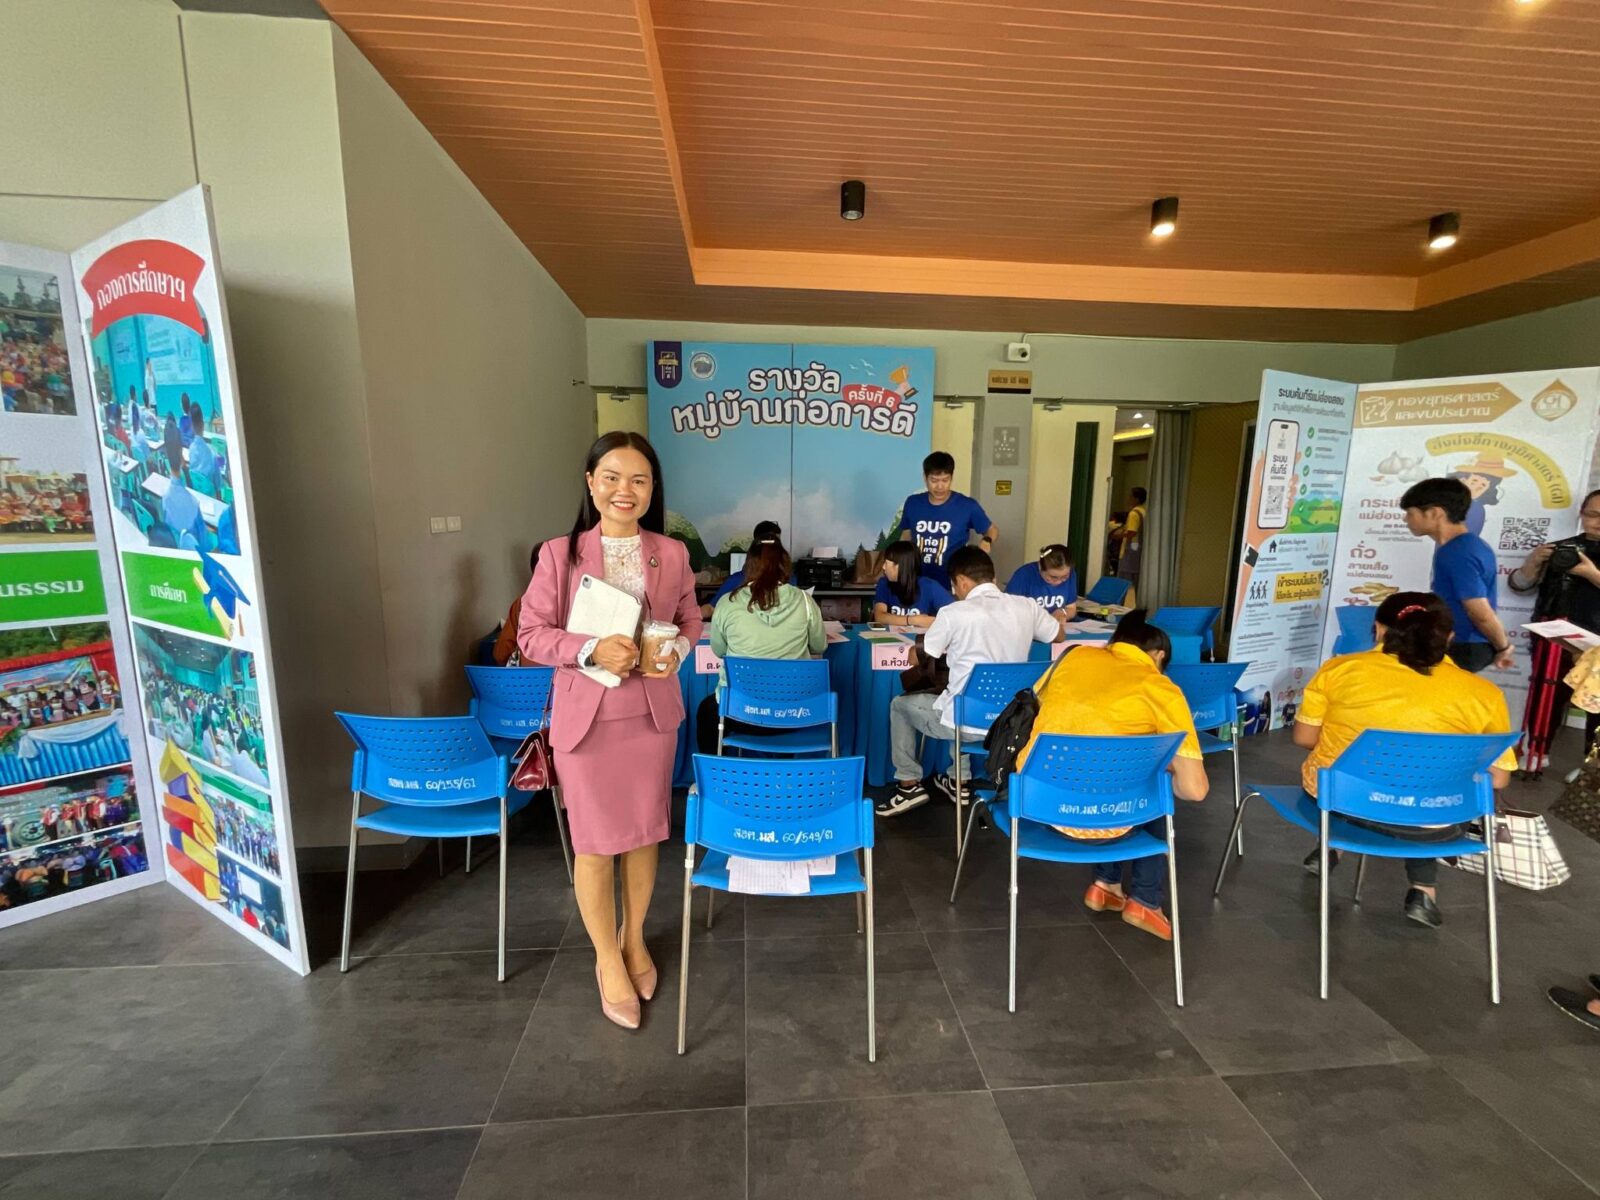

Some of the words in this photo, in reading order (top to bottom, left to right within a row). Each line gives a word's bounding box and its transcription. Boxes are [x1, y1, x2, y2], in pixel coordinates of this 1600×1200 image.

[749, 362, 840, 393] รางวัล
[848, 384, 884, 403] ครั้งที่
[886, 398, 895, 408] 6
[1397, 387, 1502, 406] กองยุทธศาสตร์
[671, 390, 917, 437] หมู่บ้านก่อการดี
[1395, 406, 1491, 420] และงบประมาณ
[916, 520, 951, 534] อบจ
[924, 536, 938, 546] ก่อ
[1350, 540, 1376, 559] ถั่ว
[923, 554, 933, 564] ดี
[150, 582, 187, 603] การศึกษา
[1036, 595, 1064, 608] อบจ
[881, 656, 912, 667] ต.ห้วย
